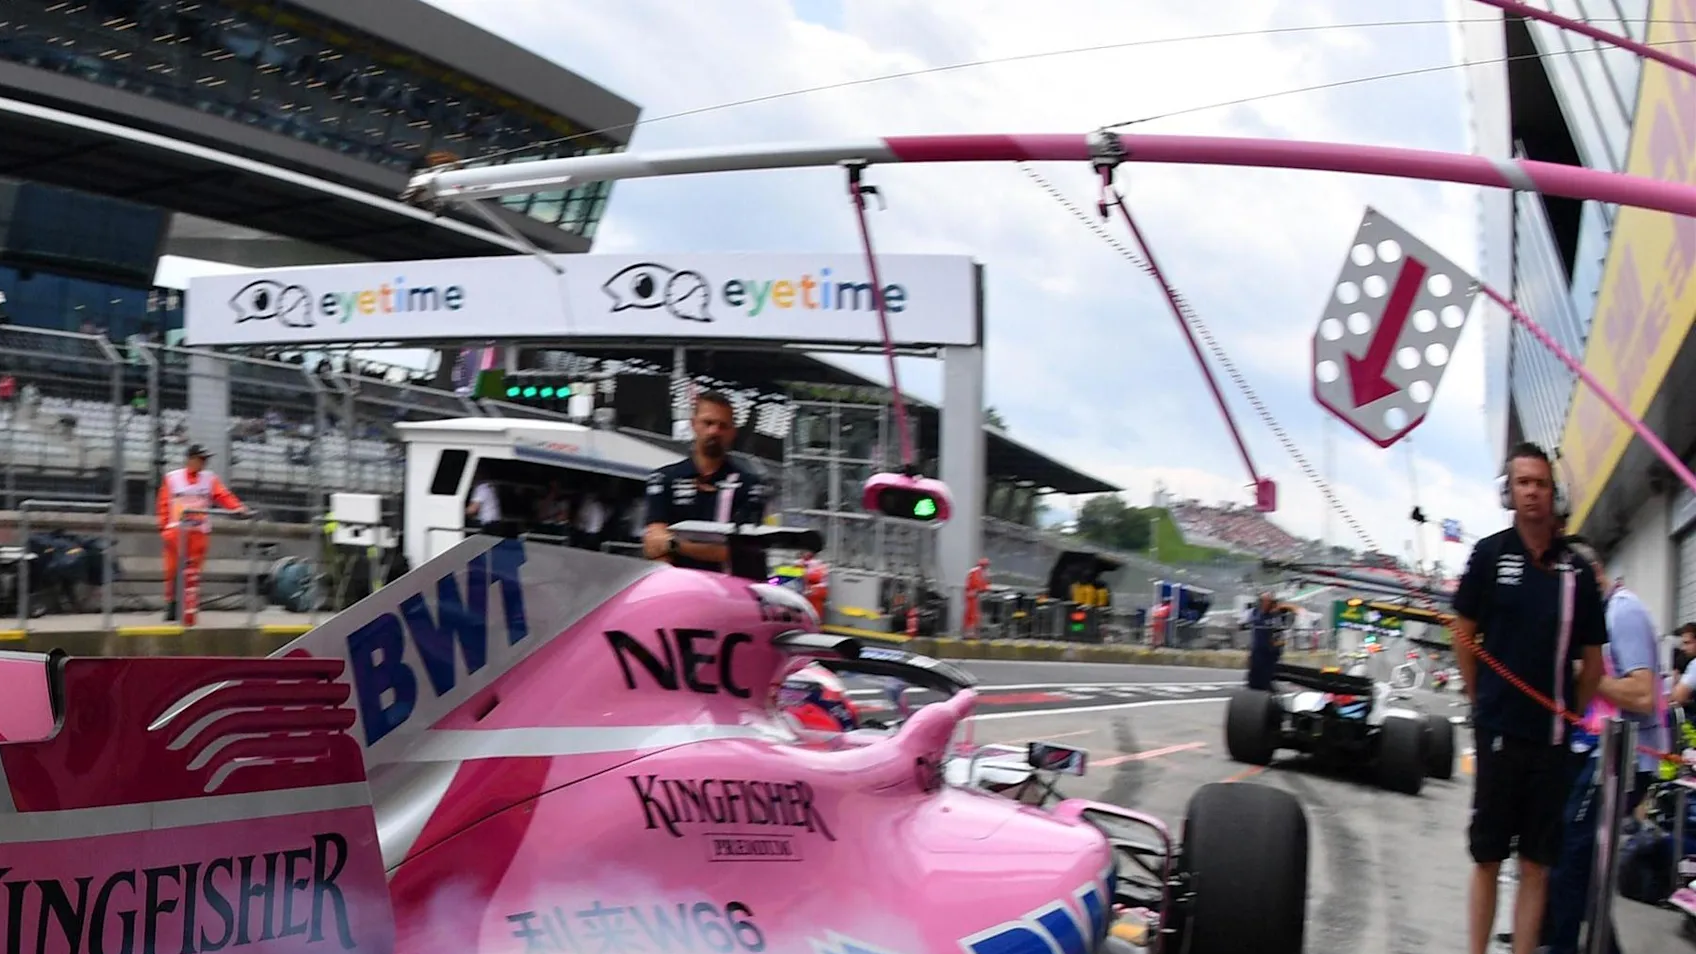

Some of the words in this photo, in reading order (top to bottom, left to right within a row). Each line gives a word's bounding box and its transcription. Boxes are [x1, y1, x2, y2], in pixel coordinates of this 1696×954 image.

[319, 276, 465, 323] eyetime
[722, 267, 909, 317] eyetime
[346, 537, 530, 747] BWT
[604, 627, 754, 699] NEC
[627, 773, 837, 841] KINGFISHER
[714, 837, 793, 857] PREMIUM
